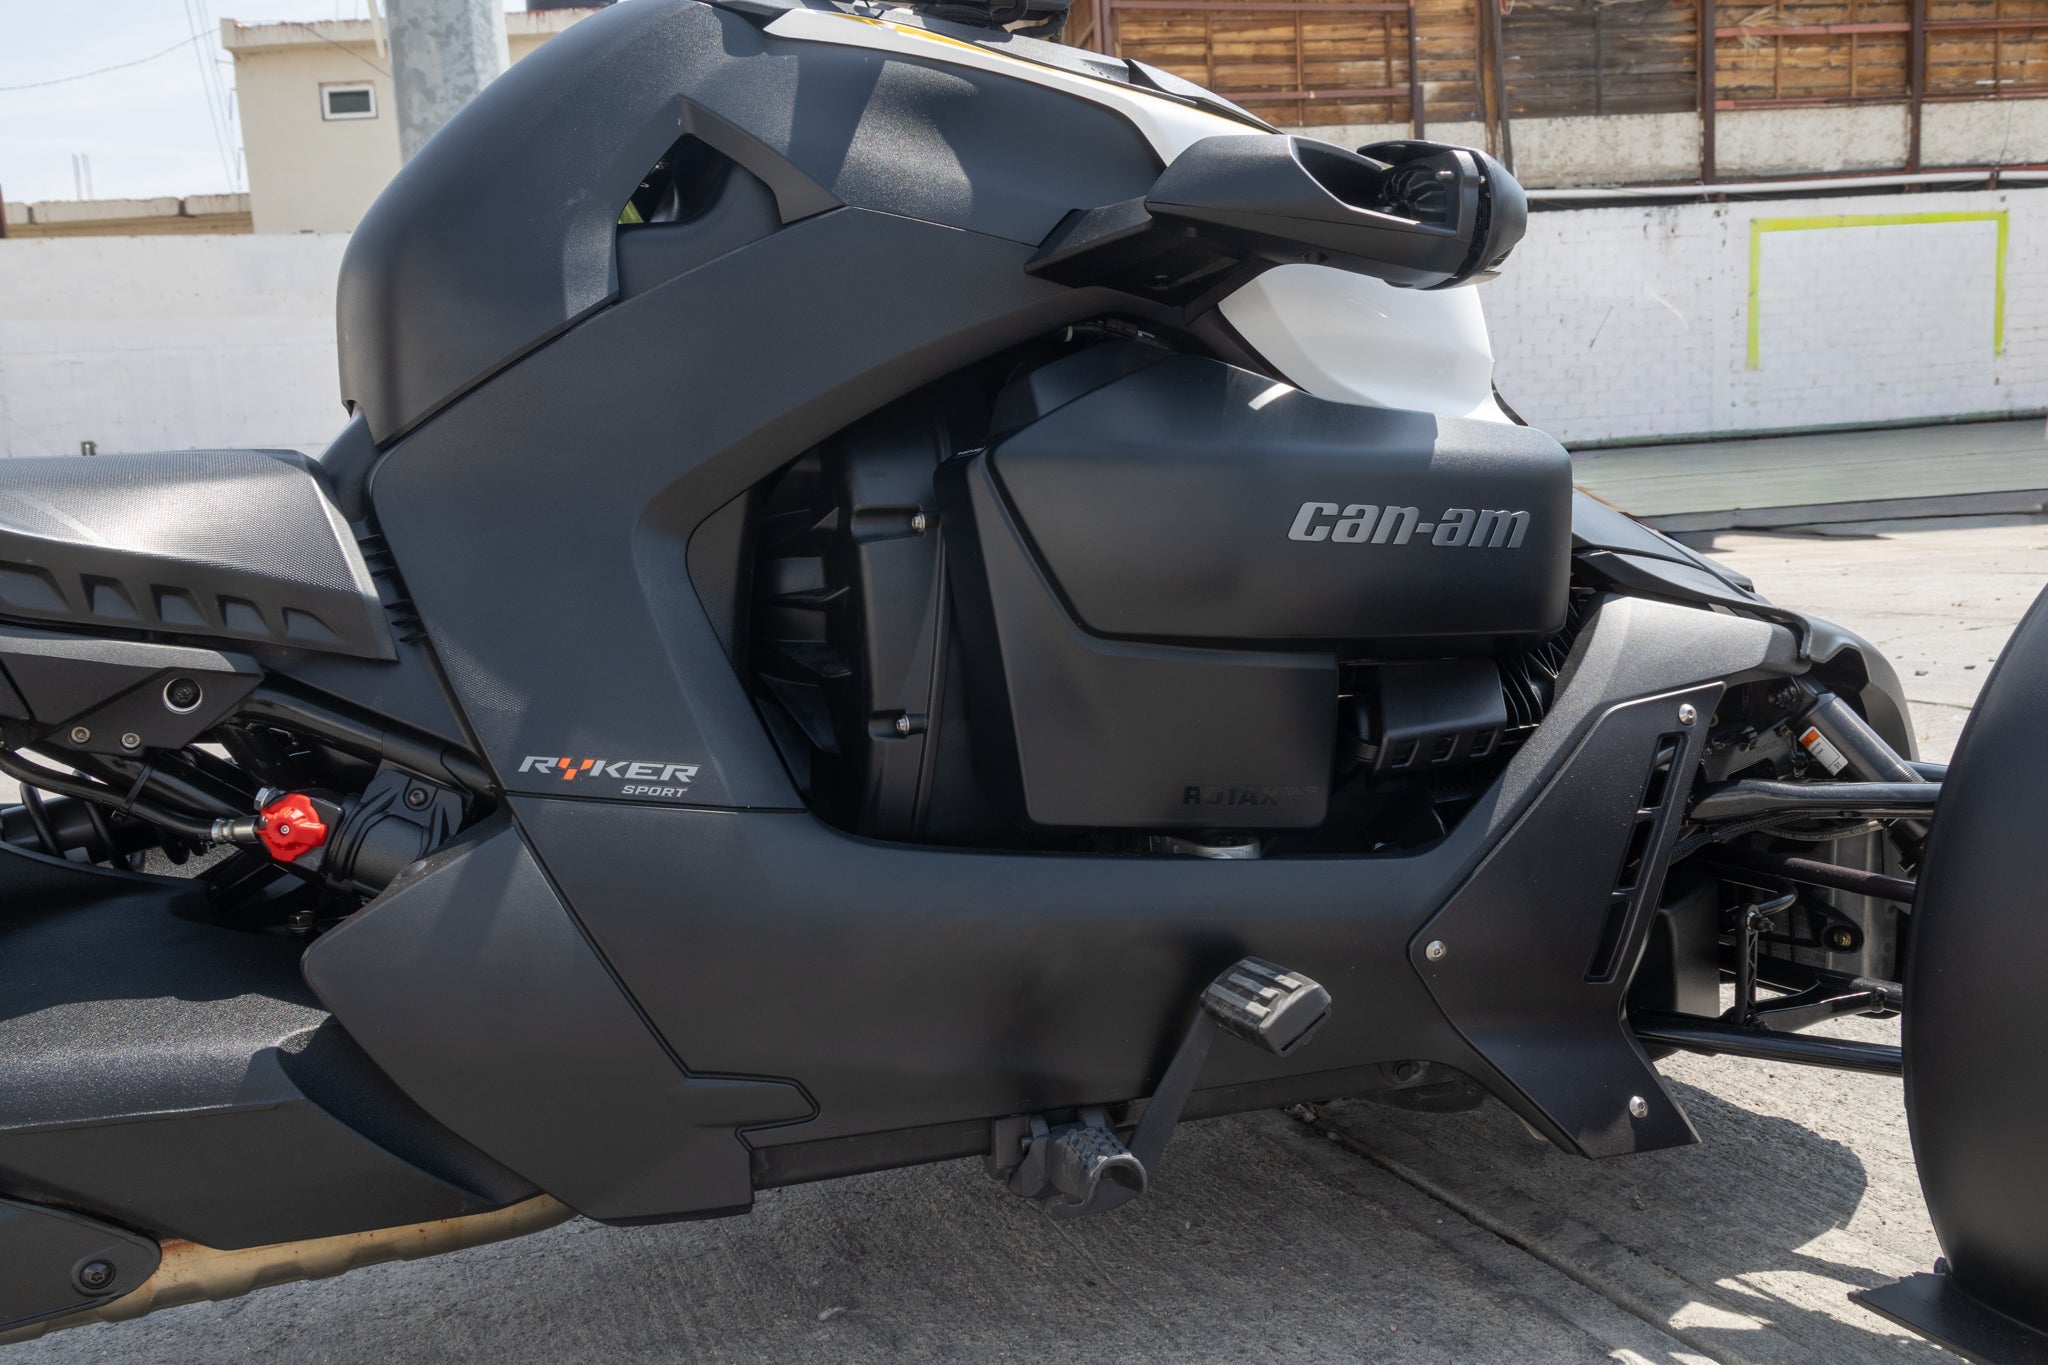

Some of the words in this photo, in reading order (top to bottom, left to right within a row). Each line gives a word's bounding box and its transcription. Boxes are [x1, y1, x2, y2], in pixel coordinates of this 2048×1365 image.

[518, 755, 701, 783] RYKER
[622, 785, 688, 798] SPORT
[1183, 786, 1279, 806] ROTAX
